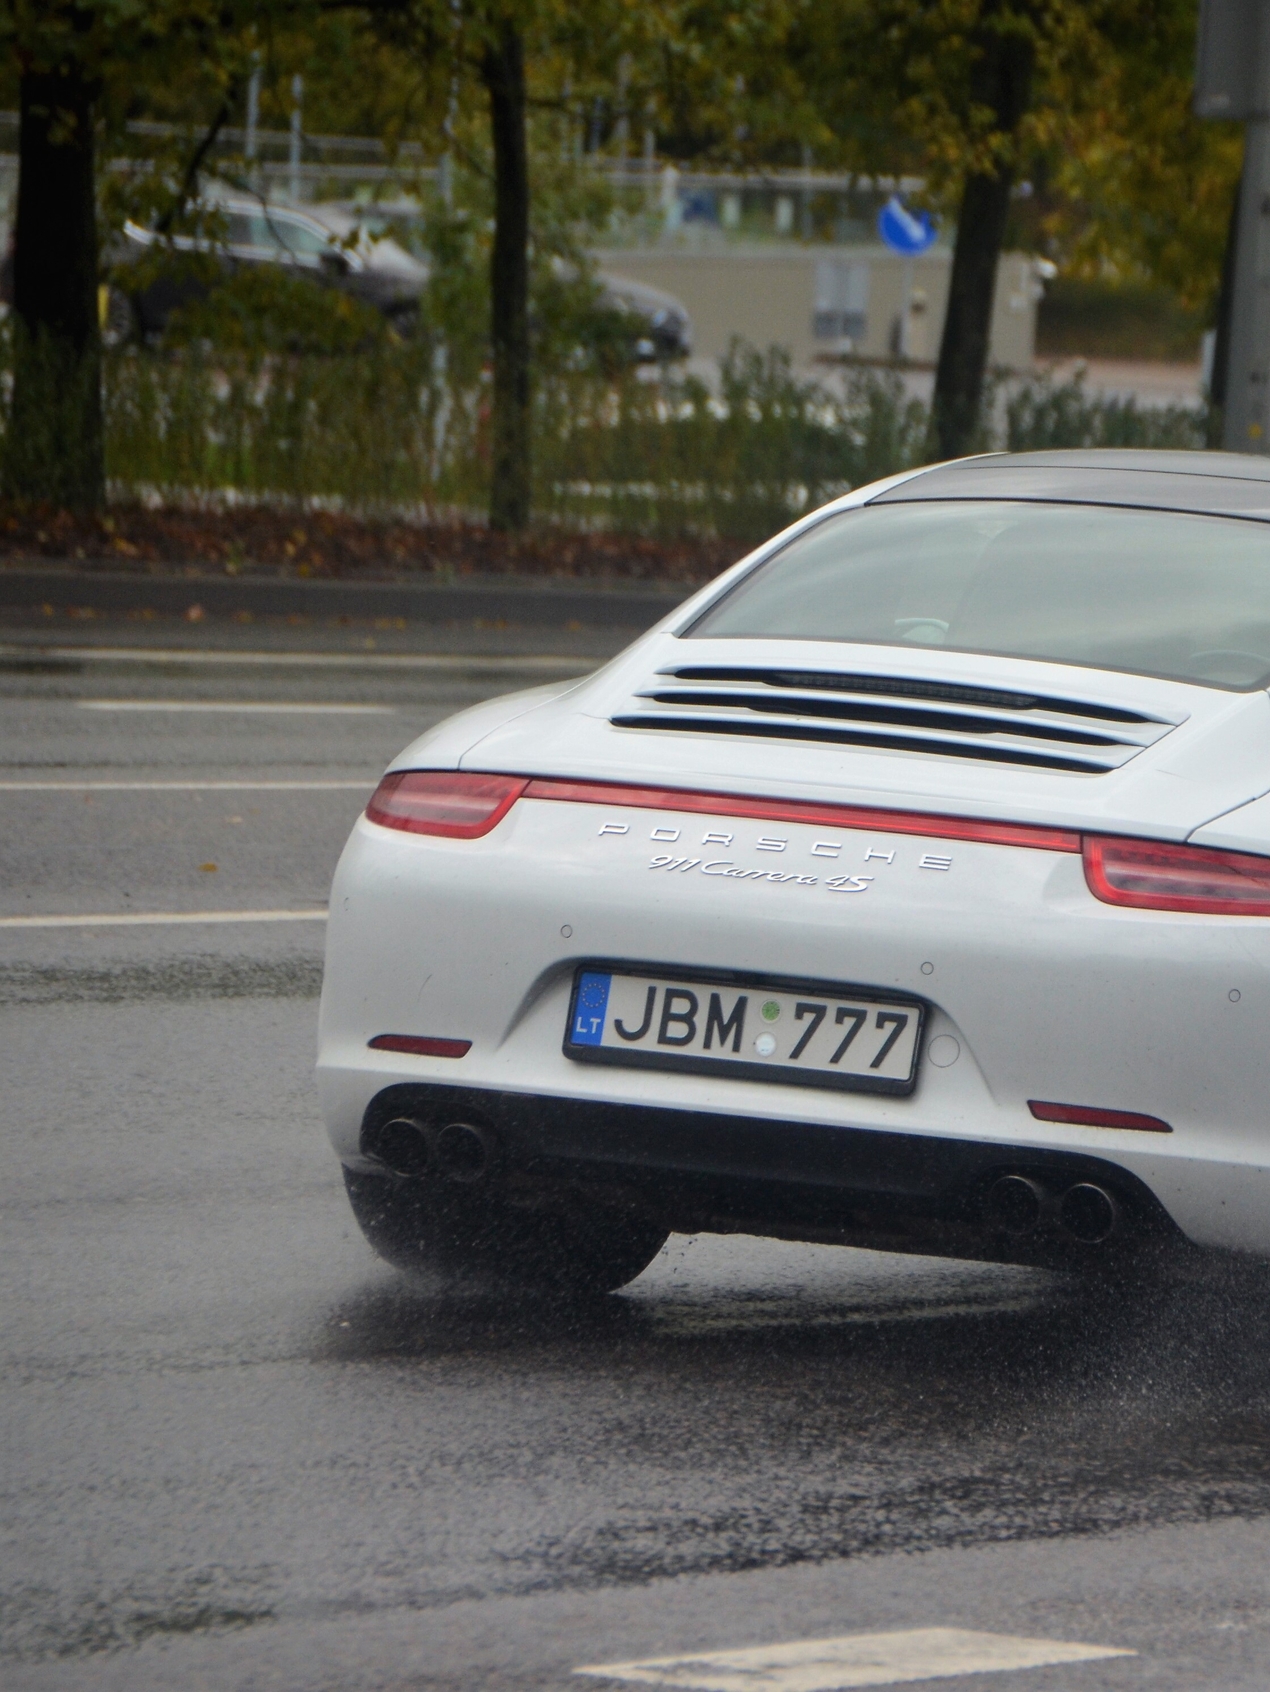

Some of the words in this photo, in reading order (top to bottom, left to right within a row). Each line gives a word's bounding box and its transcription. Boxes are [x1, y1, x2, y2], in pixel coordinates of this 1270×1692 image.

[598, 822, 953, 871] PORSCHE
[649, 855, 702, 873] 911
[700, 860, 818, 885] Carrera
[825, 874, 875, 892] 4S
[576, 1016, 602, 1034] LT
[614, 986, 748, 1053] JBM
[788, 1002, 909, 1068] 777
